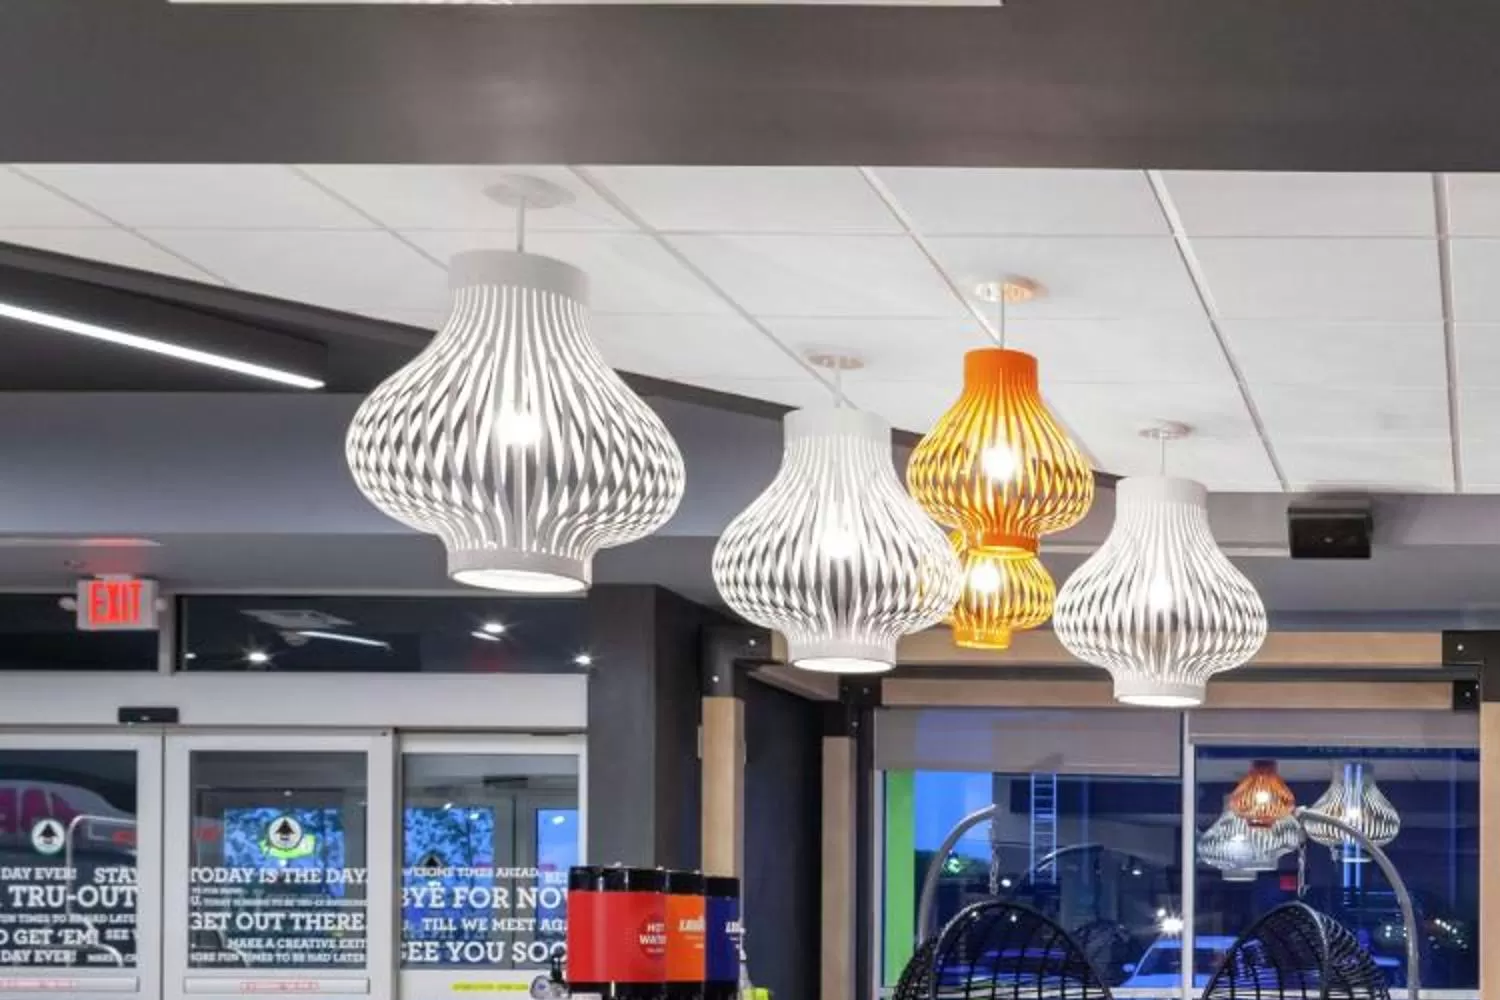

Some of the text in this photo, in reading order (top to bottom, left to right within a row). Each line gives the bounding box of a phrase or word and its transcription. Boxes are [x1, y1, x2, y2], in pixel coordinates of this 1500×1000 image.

[88, 581, 142, 624] EXIT
[1, 867, 32, 880] DAY
[191, 867, 251, 884] TODAY
[259, 868, 280, 884] IS
[284, 868, 321, 884] THE
[8, 884, 137, 908] TRU-OUT
[453, 887, 511, 909] FOR
[516, 887, 568, 909] NO
[109, 913, 137, 924] LATE
[236, 912, 285, 931] OUT
[422, 918, 456, 931] TILL
[461, 918, 489, 931] WE
[491, 918, 537, 931] MEET
[540, 918, 568, 931] AG
[13, 929, 54, 945] GET
[227, 938, 263, 949] MAKE
[264, 938, 275, 949] A
[277, 938, 337, 949] CREATIVE
[1, 950, 32, 962] DAY
[446, 941, 507, 963] YOU
